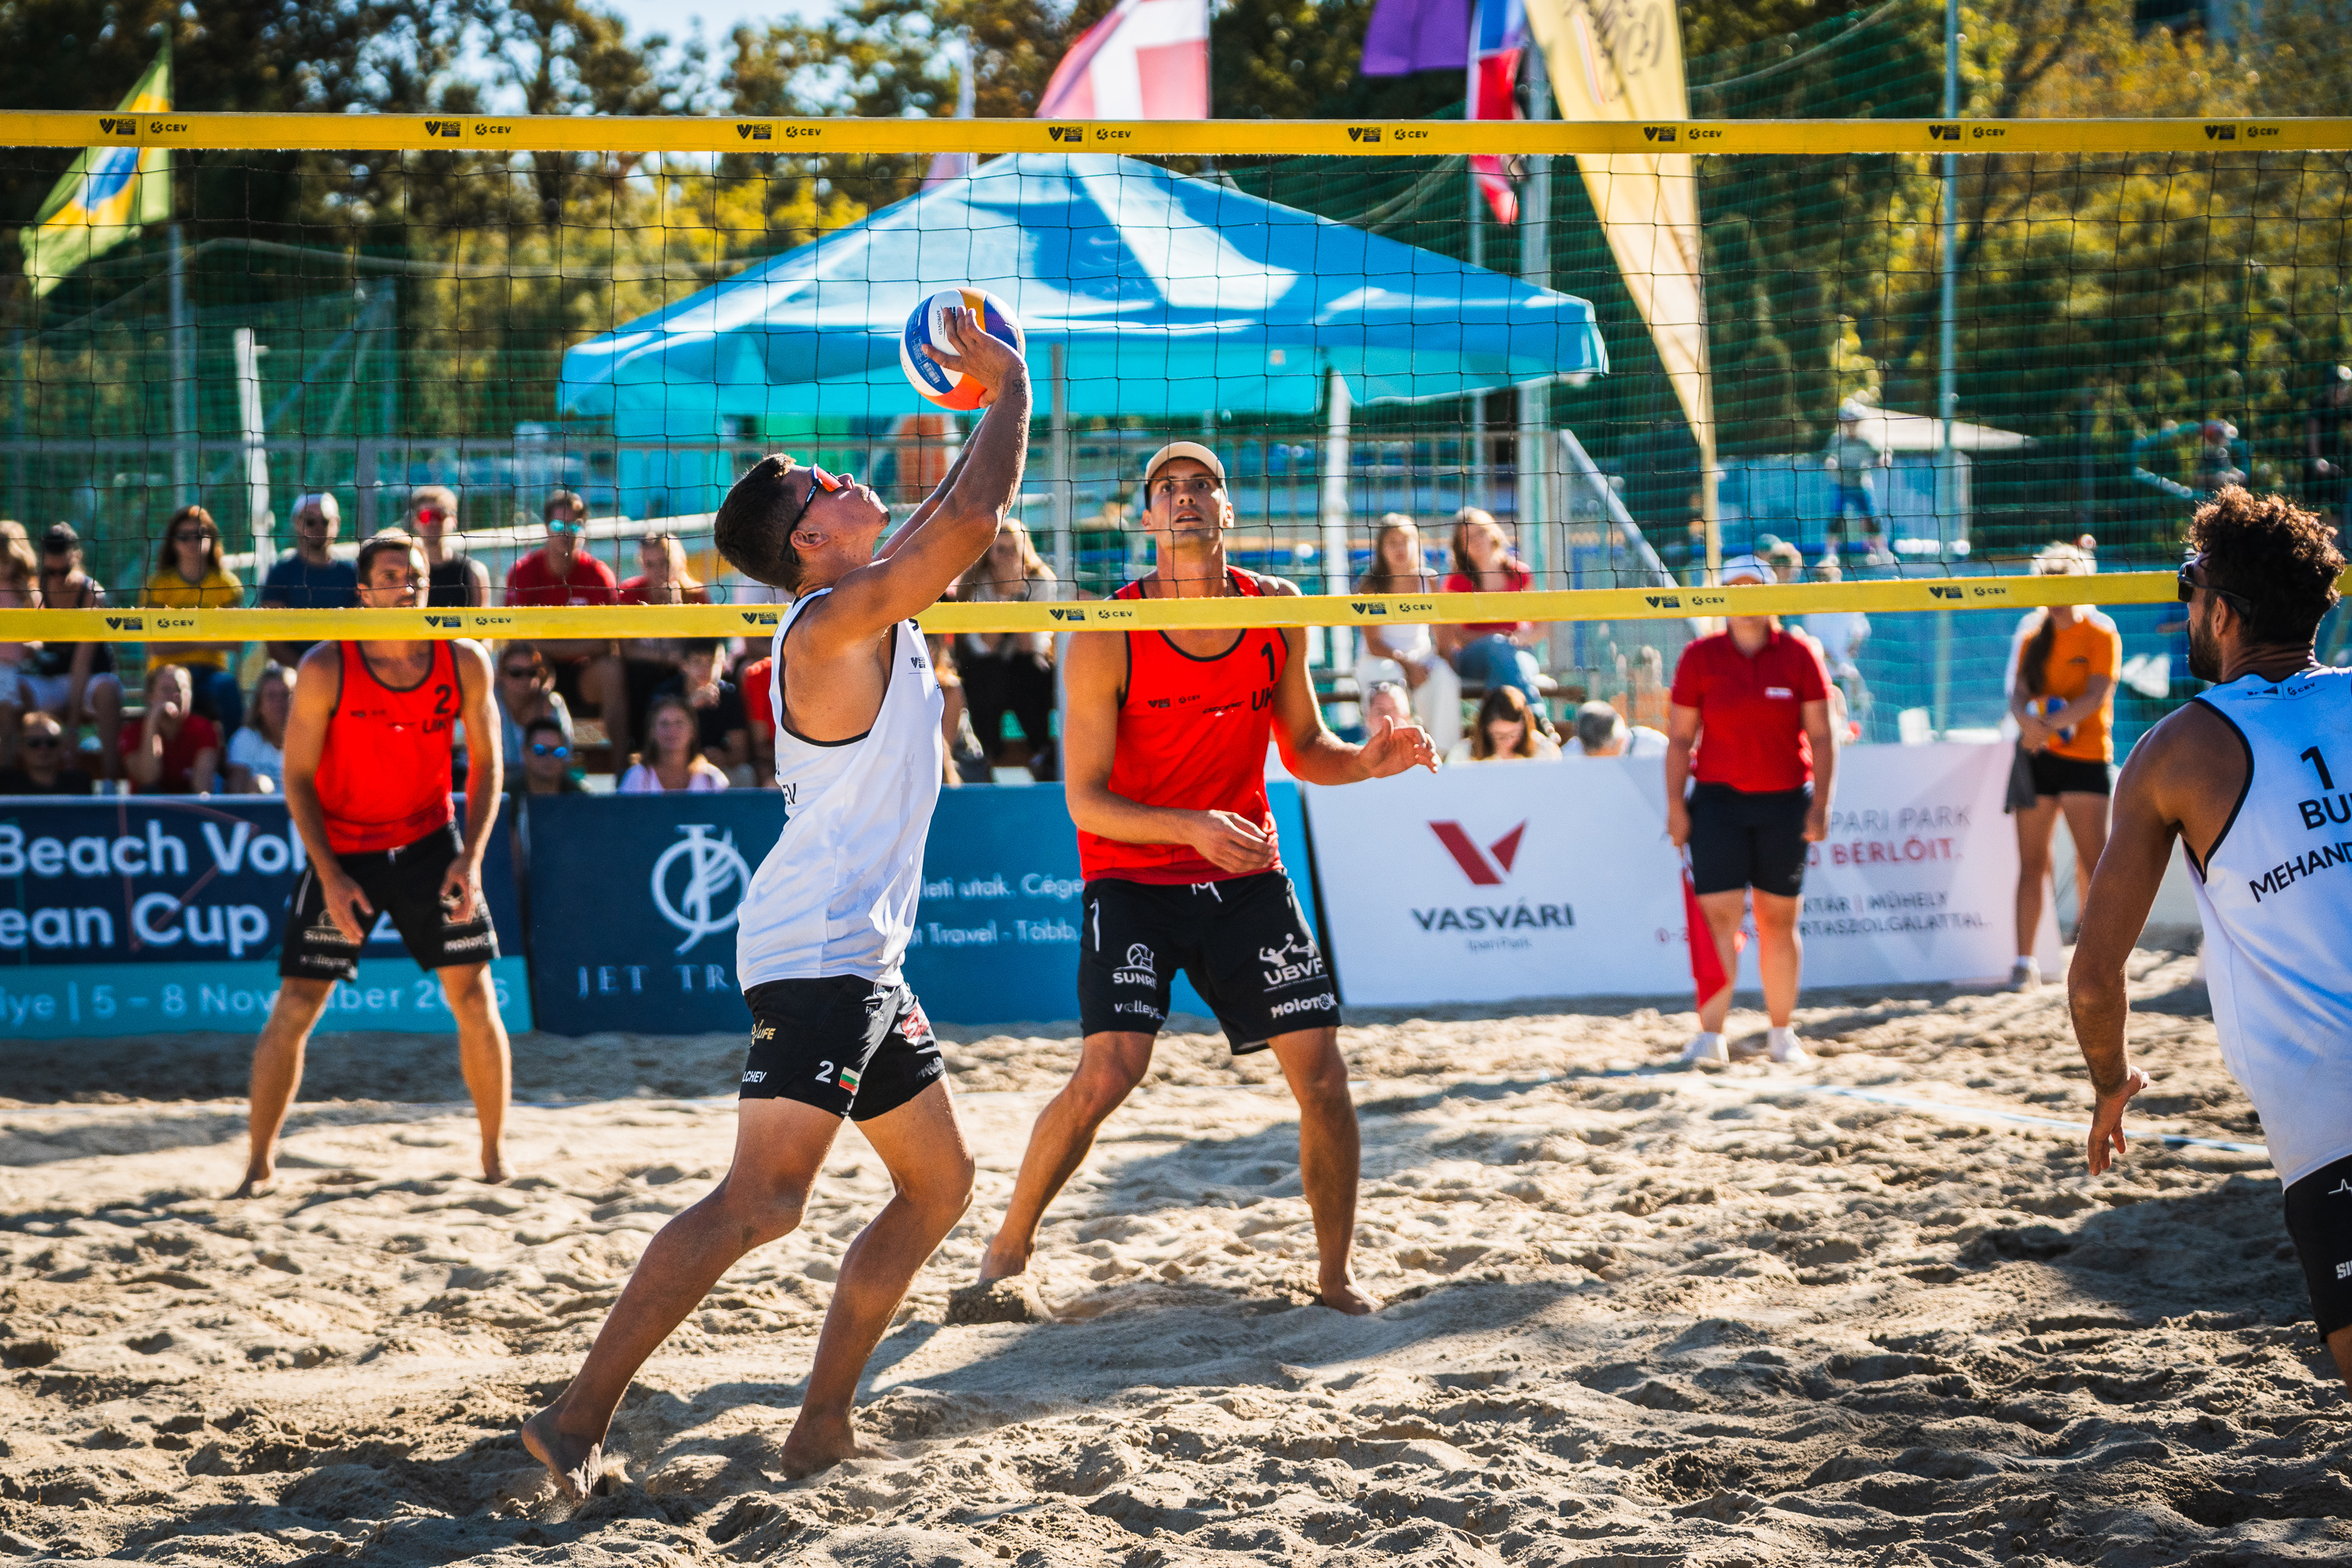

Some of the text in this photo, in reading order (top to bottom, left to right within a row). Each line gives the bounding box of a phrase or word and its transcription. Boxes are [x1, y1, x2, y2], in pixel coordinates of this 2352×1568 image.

[1261, 642, 1275, 681] 1
[434, 684, 452, 714] 2
[2300, 746, 2335, 790] 1
[1899, 805, 1970, 829] PARK
[2298, 793, 2352, 830] BU
[0, 818, 188, 877] Beach
[0, 907, 114, 949] ean
[130, 891, 270, 956] Cup
[1410, 897, 1573, 930] VASVÁRI
[926, 919, 997, 945] Travel
[578, 964, 735, 999] JET TR
[1263, 956, 1323, 985] UBVF
[92, 985, 116, 1018] 5
[162, 983, 187, 1018] 8
[199, 981, 403, 1016] Novber
[815, 1060, 834, 1083] 2
[2336, 1260, 2352, 1279] SI
